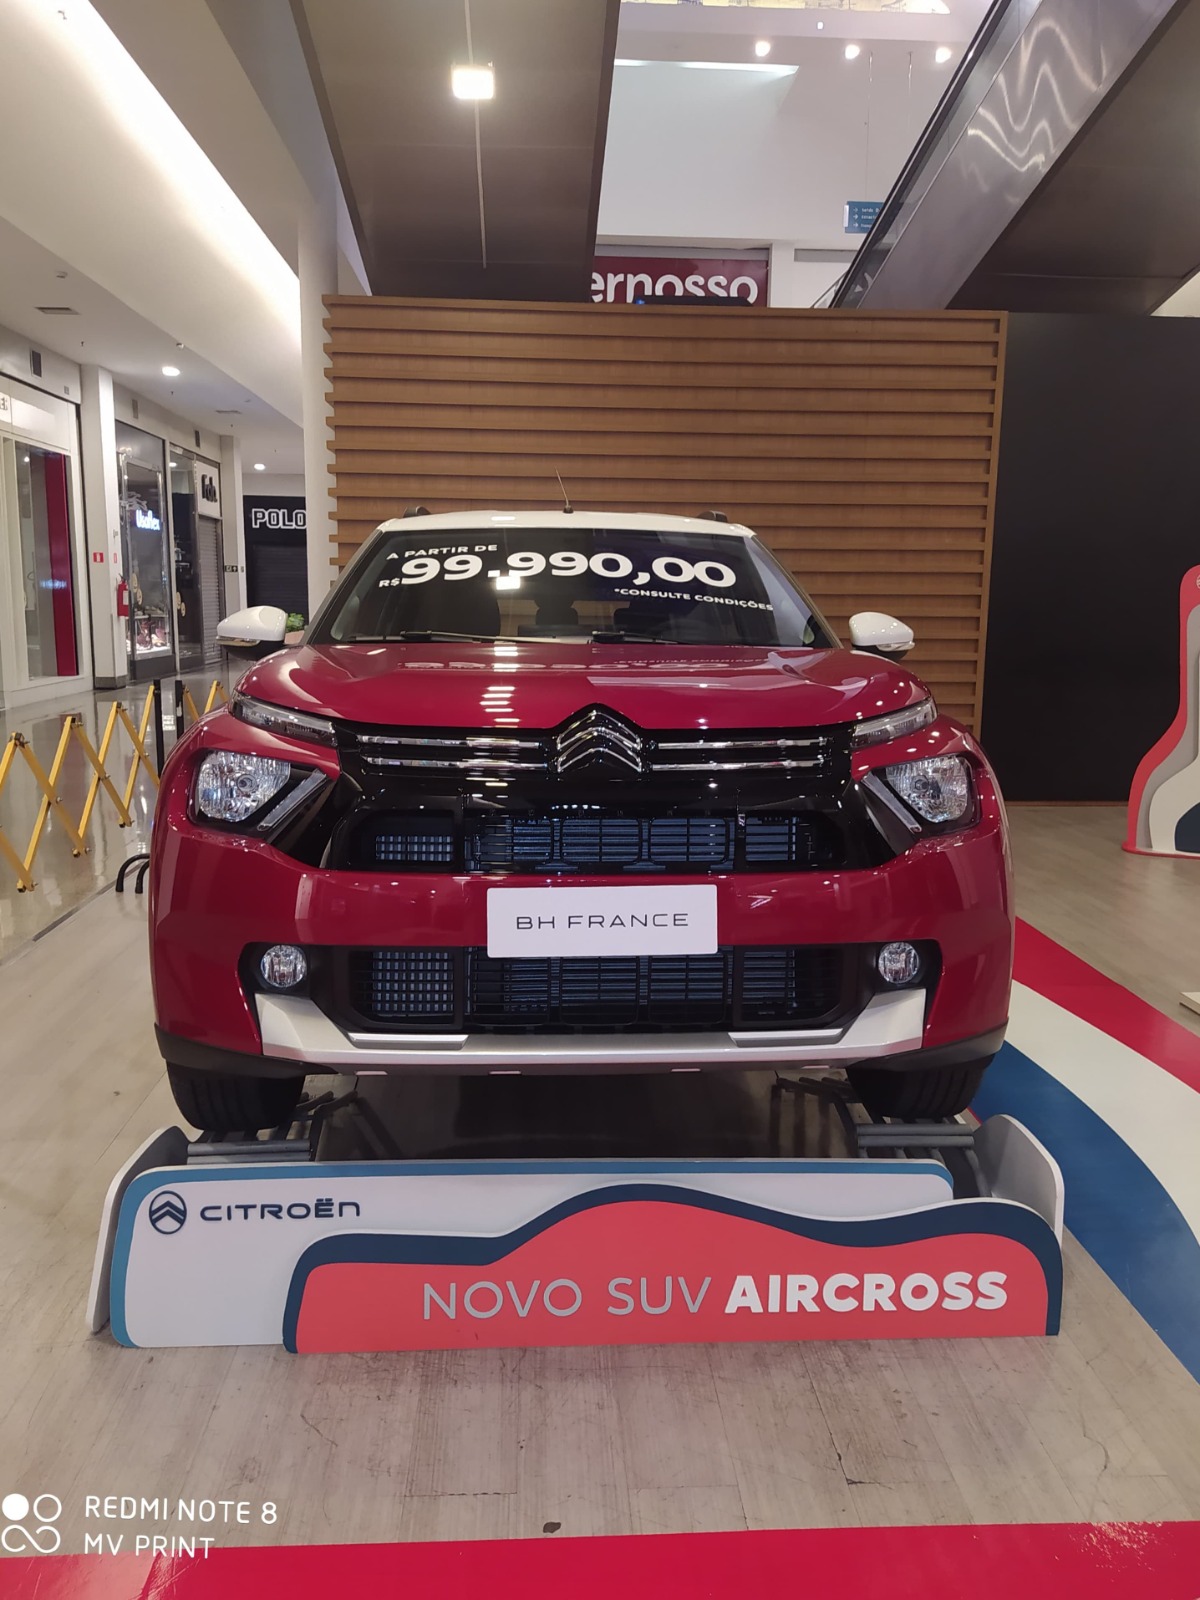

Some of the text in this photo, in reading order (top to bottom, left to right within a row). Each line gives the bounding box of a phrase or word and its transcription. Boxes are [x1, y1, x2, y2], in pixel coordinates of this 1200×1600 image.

[252, 508, 307, 529] POLO
[386, 544, 498, 560] A PARTIR DE
[378, 551, 736, 588] R$ 99.990,00
[694, 594, 774, 611] CONDIÇÕES
[516, 913, 689, 929] BH FRANCE
[423, 1271, 1008, 1320] NOVO SUV AIRCROSS
